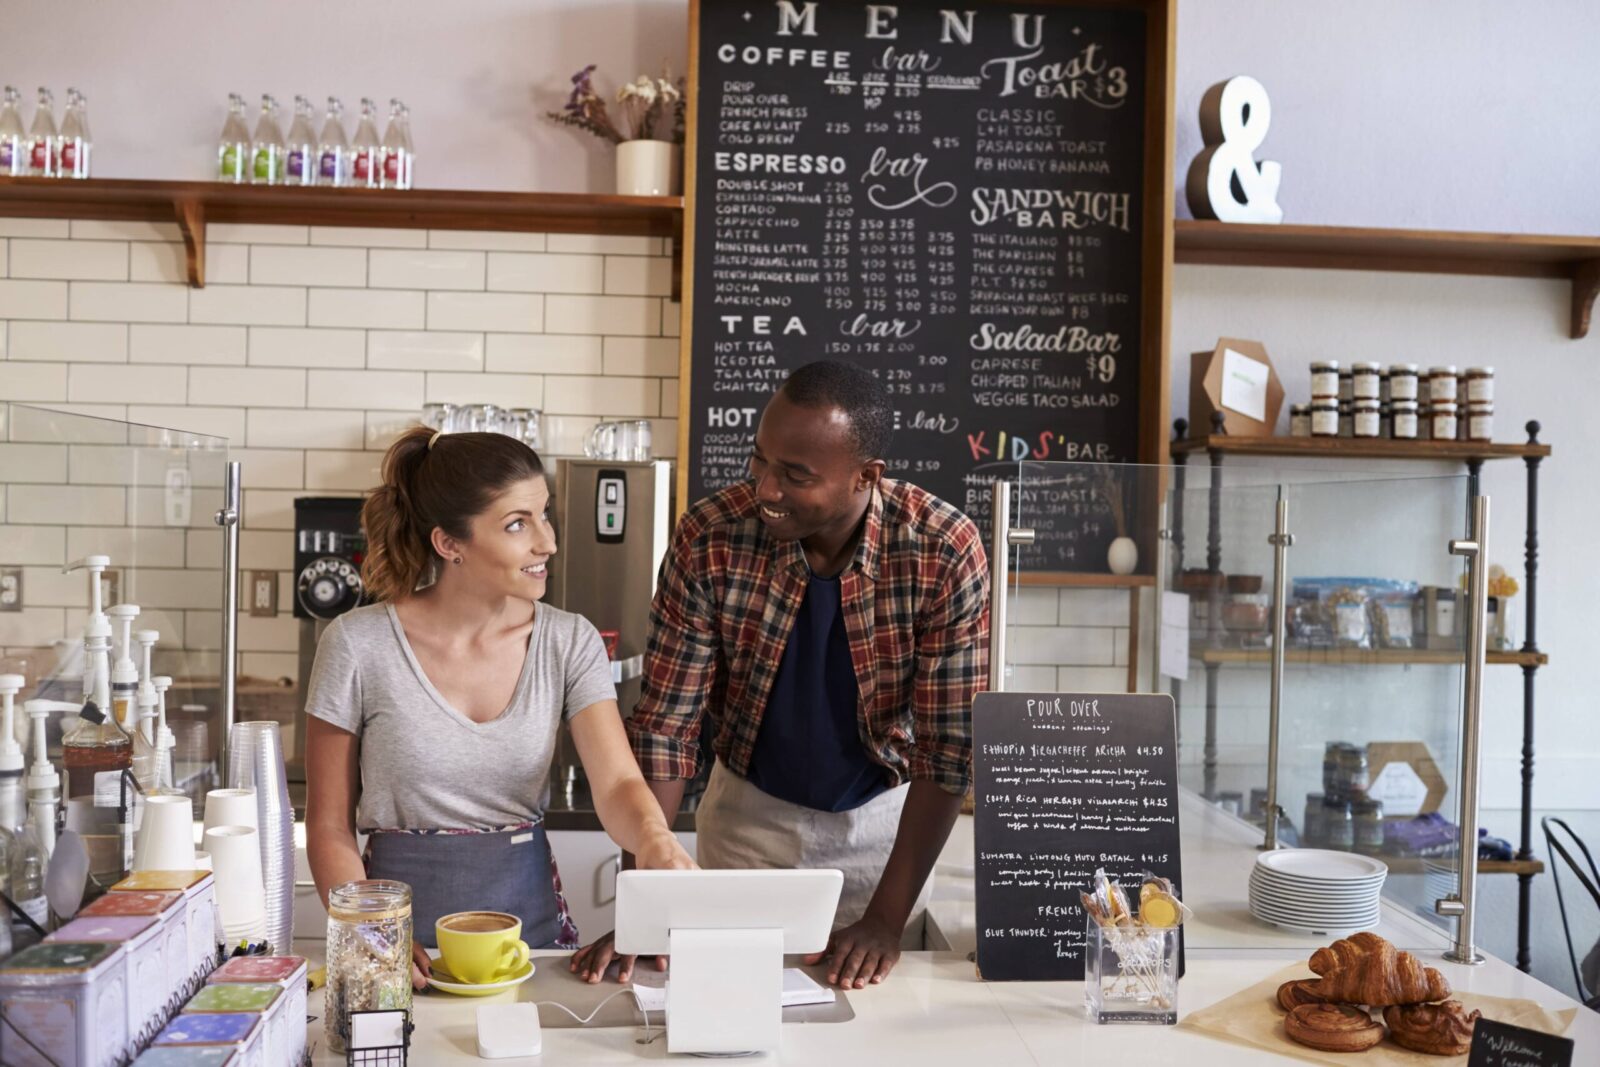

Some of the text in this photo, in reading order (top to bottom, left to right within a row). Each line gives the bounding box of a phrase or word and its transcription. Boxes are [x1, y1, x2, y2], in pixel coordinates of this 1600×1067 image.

[776, 0, 1046, 49] MENU
[718, 44, 942, 71] COFFEE bar
[981, 42, 1107, 97] Toast
[723, 81, 755, 92] DRIP
[1035, 66, 1128, 104] BAR $3
[722, 94, 789, 104] POUR OVER
[720, 107, 808, 118] FRENCH PRESS
[977, 108, 1056, 122] CLASSIC
[719, 120, 802, 131] CAFE AU LAIT
[1014, 125, 1064, 137] TOAST
[719, 134, 795, 145] COLD BREW
[976, 139, 1107, 153] PASADENA TOAST
[714, 151, 846, 174] ESPRESSO
[975, 156, 1110, 174] PB HONEY BANANA
[717, 179, 804, 192] DOUBLE SHOT
[715, 204, 776, 215] CORTADO
[970, 187, 1131, 231] SANDWICH
[715, 217, 800, 228] CAPPUCCINO
[1017, 210, 1089, 229] BAR
[715, 229, 760, 239] LATTE
[972, 233, 1058, 246] THE ITALIANO
[773, 244, 808, 254] LATTE
[972, 249, 994, 260] THE
[998, 250, 1056, 262] PARISIAN
[791, 258, 818, 268] LATTE
[972, 263, 994, 274] THE
[1000, 264, 1055, 276] CAPRESE
[715, 283, 760, 293] MOCHA
[714, 294, 792, 307] AMERICANO
[1027, 293, 1065, 304] ROAST
[720, 313, 921, 338] TEA bar
[714, 341, 743, 352] HOT
[747, 341, 774, 351] TEA
[714, 355, 749, 366] ICED
[751, 355, 776, 365] TEA
[970, 358, 1042, 371] CAPRESE
[714, 368, 790, 380] TEA LATTE
[1086, 354, 1116, 383] $9
[713, 381, 744, 392] CHAI
[745, 382, 770, 392] TEA
[970, 374, 1081, 389] CHOPPED ITALIAN
[972, 392, 1120, 409] VEGGIE TACO SALAD
[708, 407, 757, 428] HOT
[907, 410, 959, 433] bar
[1066, 441, 1112, 460] BAR
[966, 489, 1087, 503] BIRDAY TOAST
[1027, 698, 1102, 717] POUR OVER
[1137, 746, 1163, 756] $4.50
[1123, 768, 1149, 777] bright
[1115, 779, 1136, 790] nutty
[1140, 777, 1166, 786] finish
[1081, 814, 1104, 823] honey
[1069, 823, 1077, 831] of
[981, 852, 1022, 860] SUMATRA
[1100, 853, 1135, 863] BATAK
[1141, 854, 1168, 863] $4.15
[999, 869, 1031, 879] complex
[1034, 868, 1054, 879] body
[1038, 905, 1081, 916] FRENCH
[985, 928, 1004, 938] BLUE
